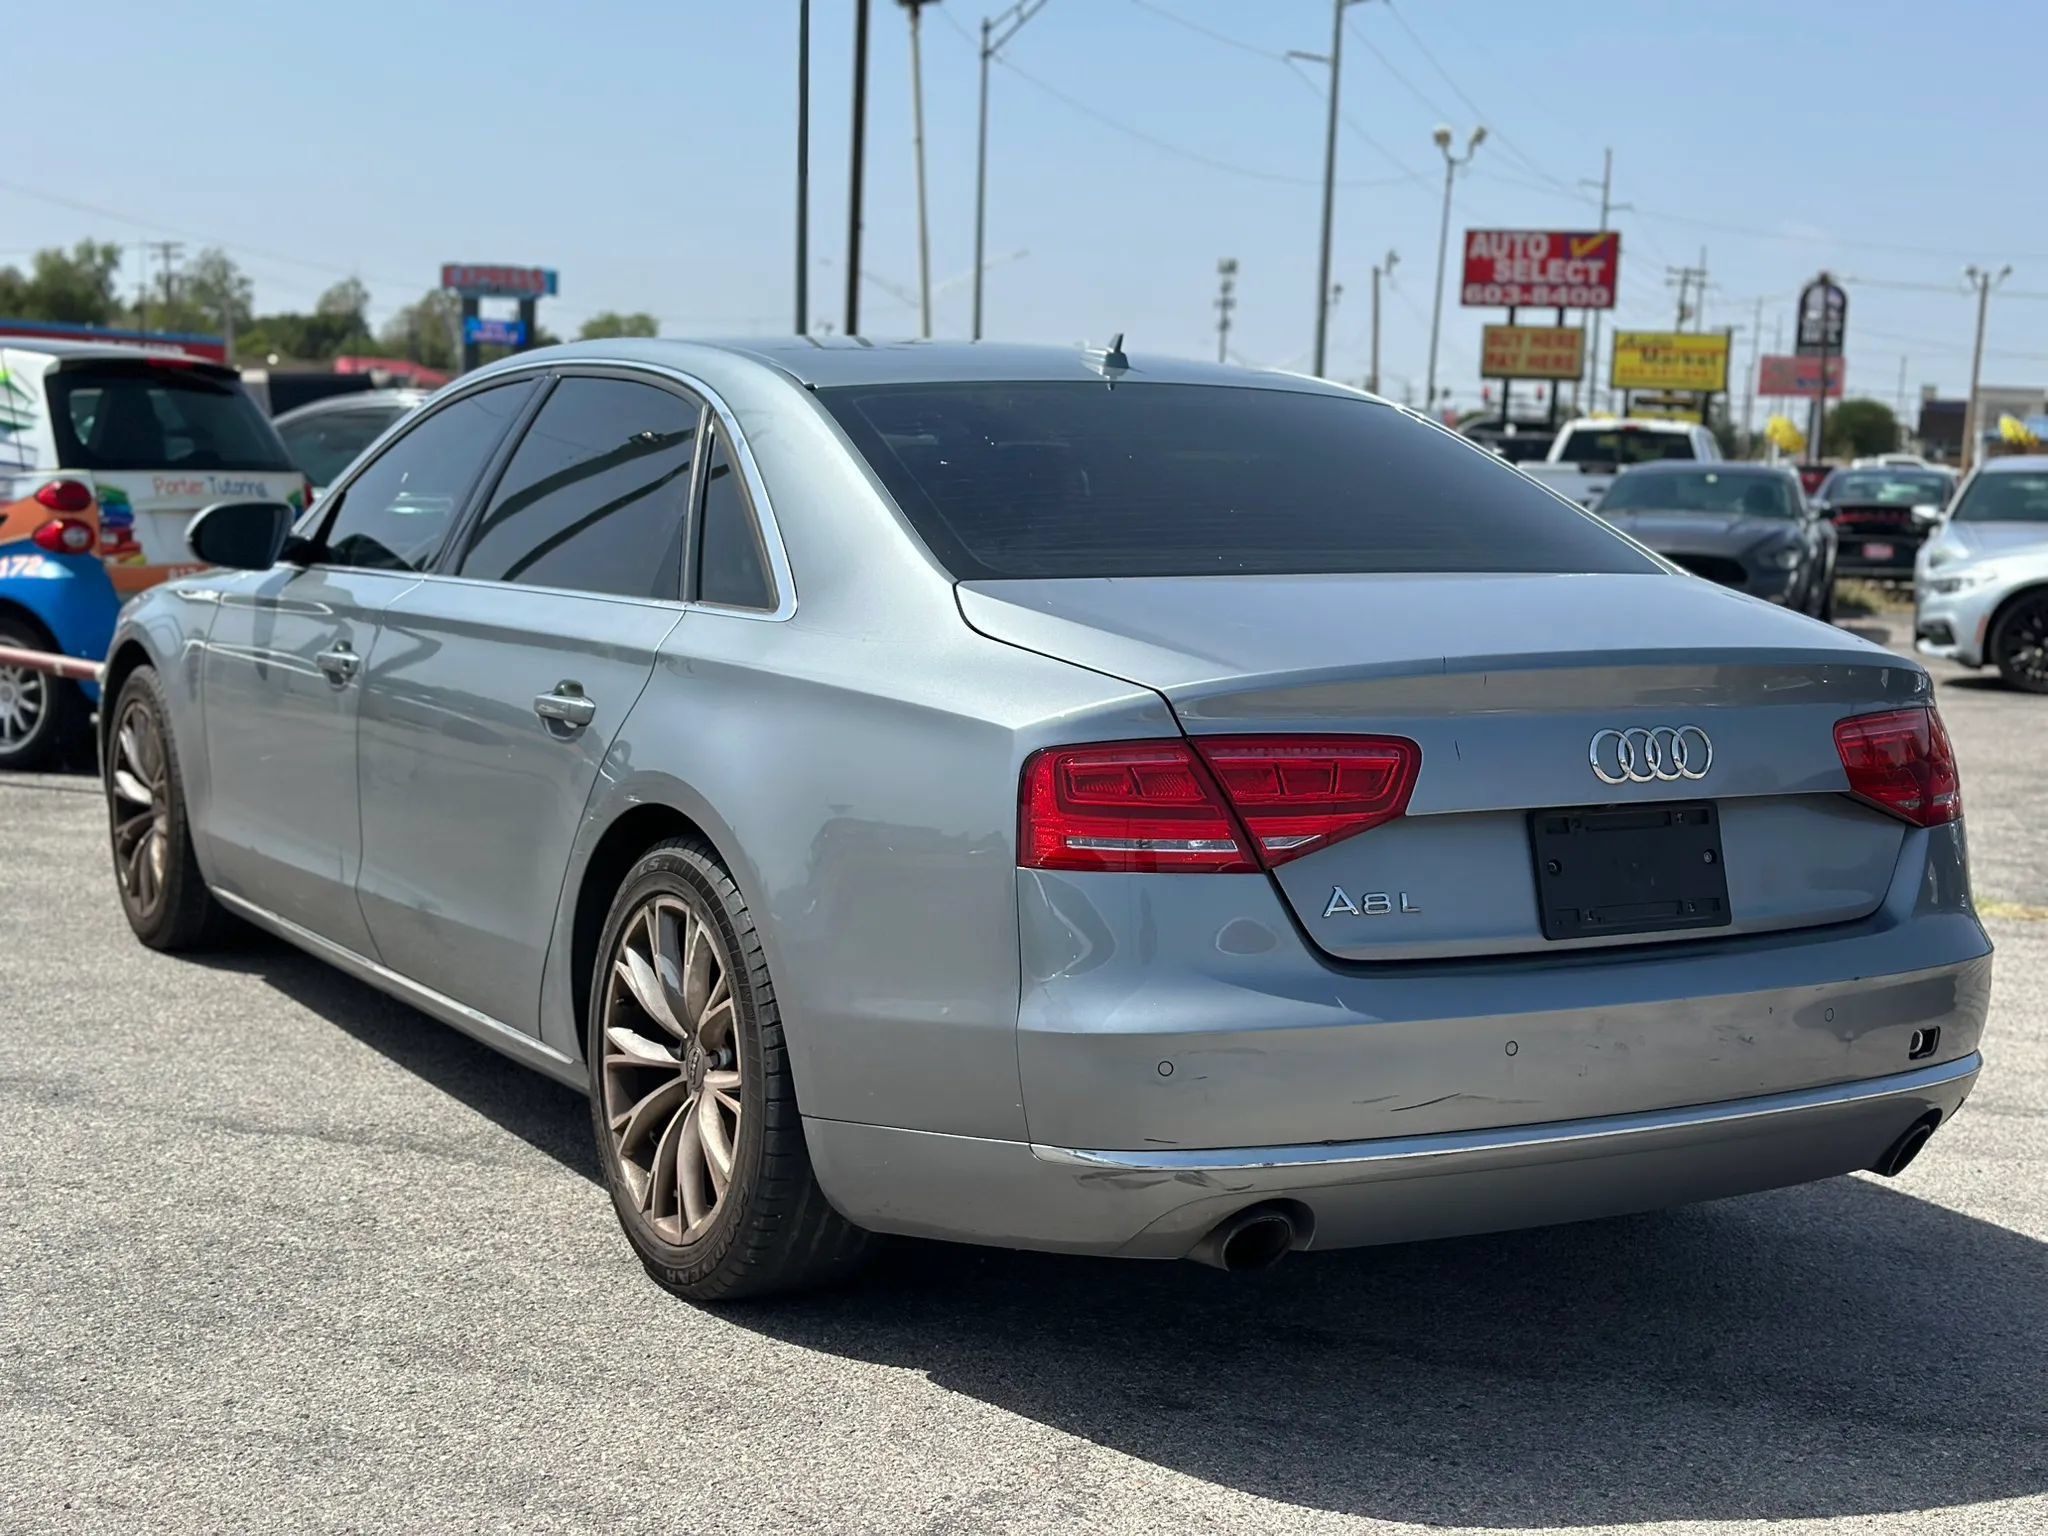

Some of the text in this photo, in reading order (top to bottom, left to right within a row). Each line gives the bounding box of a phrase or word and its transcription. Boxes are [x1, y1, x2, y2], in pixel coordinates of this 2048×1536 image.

[1468, 233, 1549, 260] AUTO
[1493, 258, 1606, 285] SELECT
[1463, 283, 1610, 306] 603-8400
[1530, 331, 1578, 349] HERE
[1526, 353, 1575, 370] HERE
[152, 475, 269, 498] Porter Tutoring
